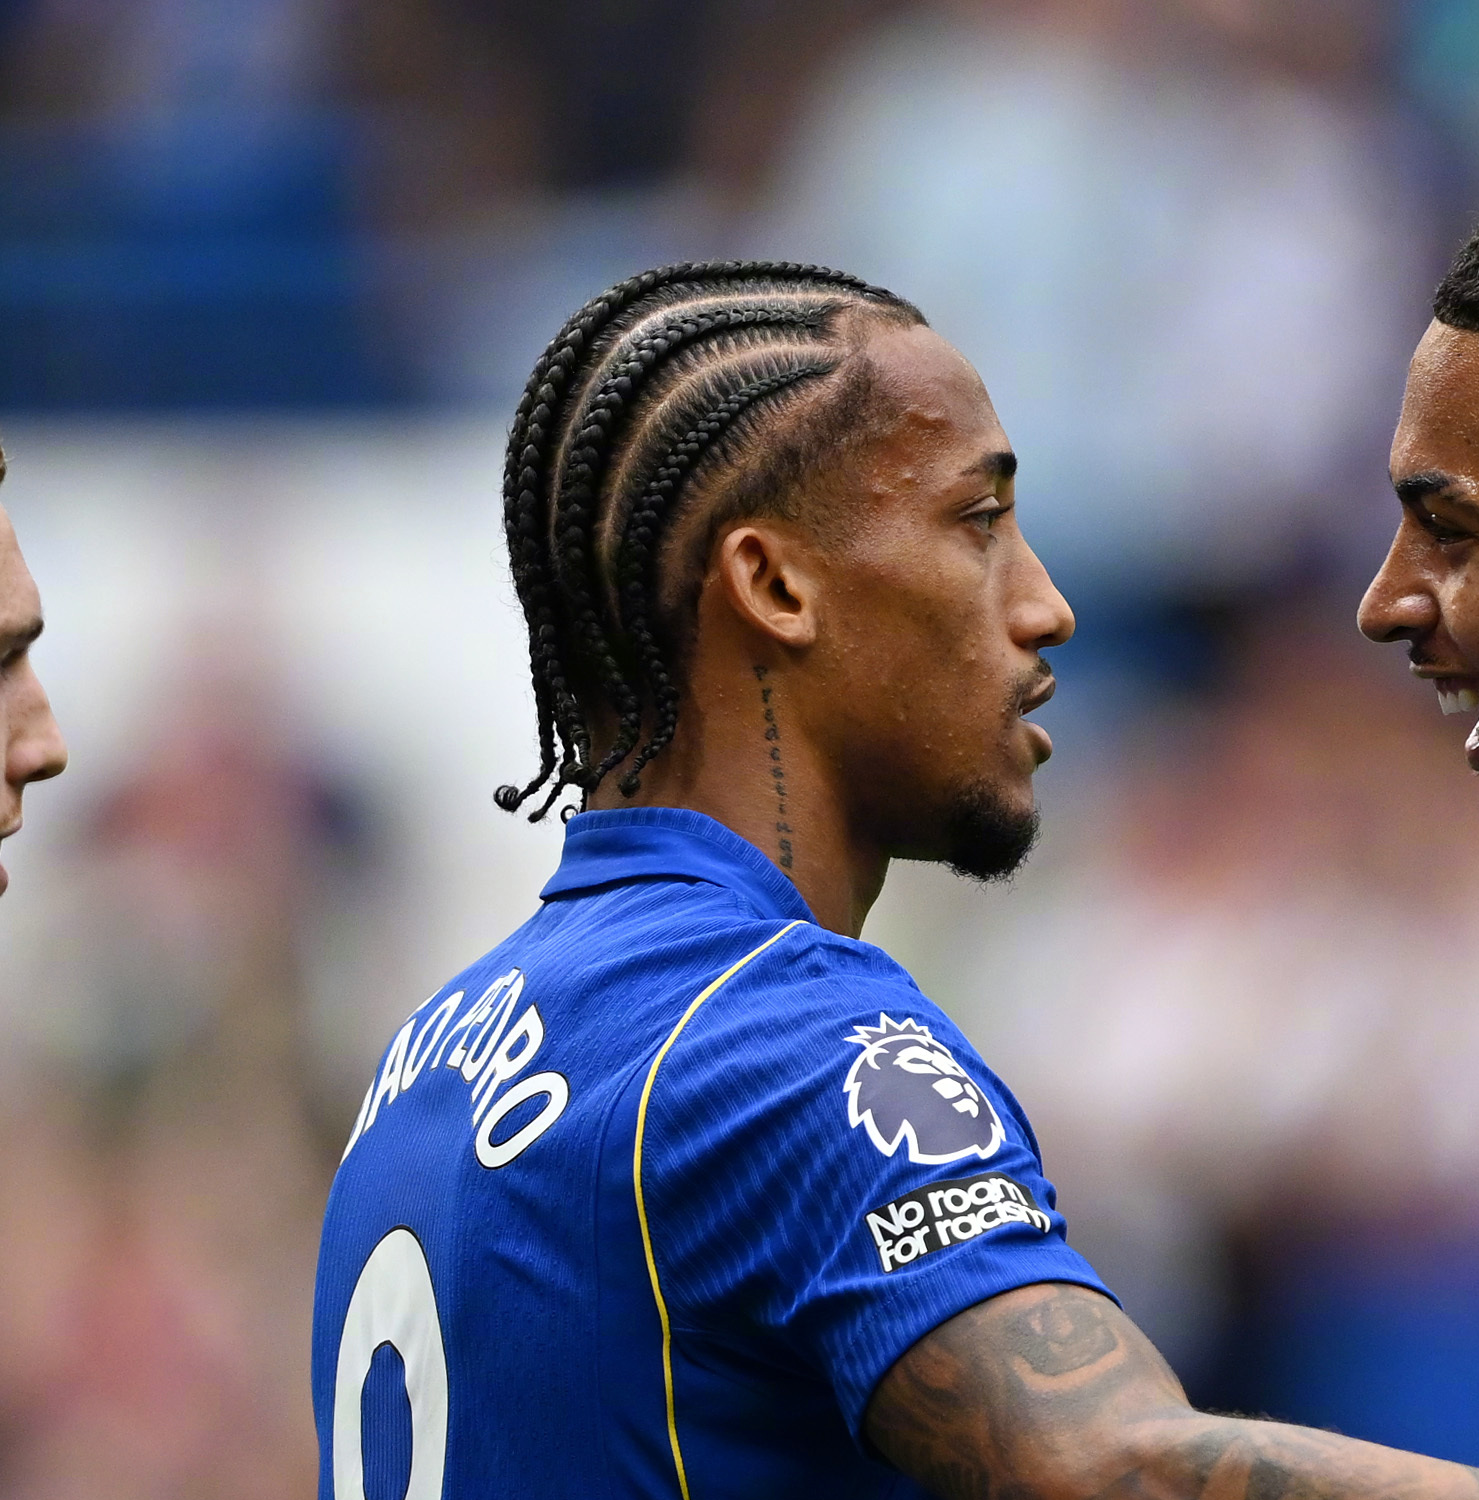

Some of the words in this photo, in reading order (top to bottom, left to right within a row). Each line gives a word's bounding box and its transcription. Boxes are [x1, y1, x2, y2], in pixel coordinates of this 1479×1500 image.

[430, 966, 570, 1170] PEDRO
[865, 1201, 925, 1247] No
[927, 1177, 1029, 1218] room
[878, 1226, 931, 1273] for
[935, 1201, 1052, 1247] racism
